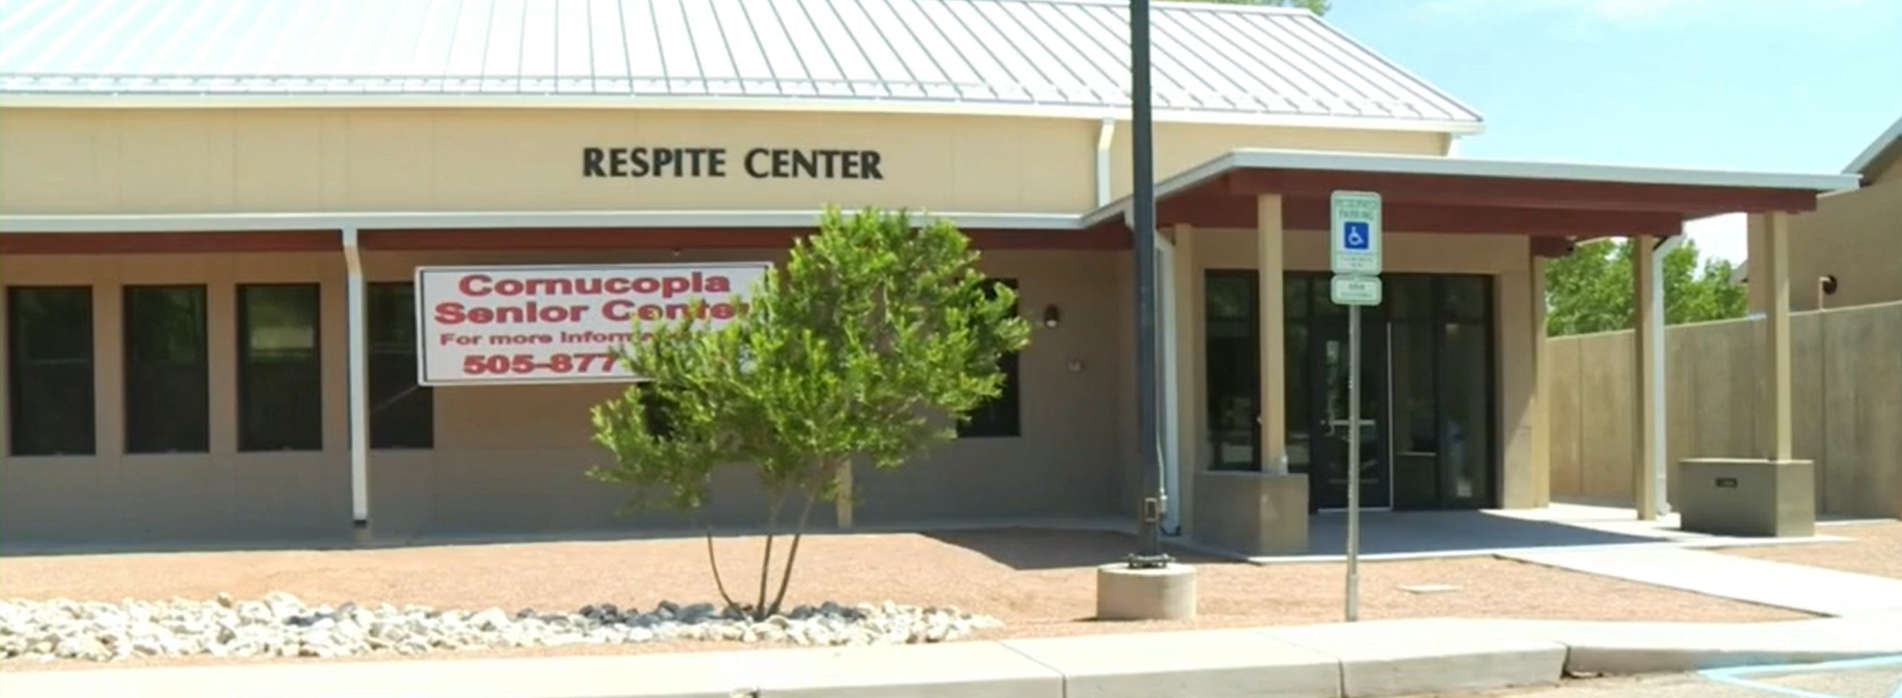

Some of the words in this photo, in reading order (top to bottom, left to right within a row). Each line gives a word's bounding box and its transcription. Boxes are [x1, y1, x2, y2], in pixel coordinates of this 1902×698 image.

[582, 147, 726, 178] RESPITE
[744, 148, 884, 179] CENTER
[458, 272, 731, 298] Cornucopia
[434, 301, 590, 325] Senior
[440, 333, 482, 345] For
[489, 333, 553, 344] more
[463, 352, 620, 375] 505-877
